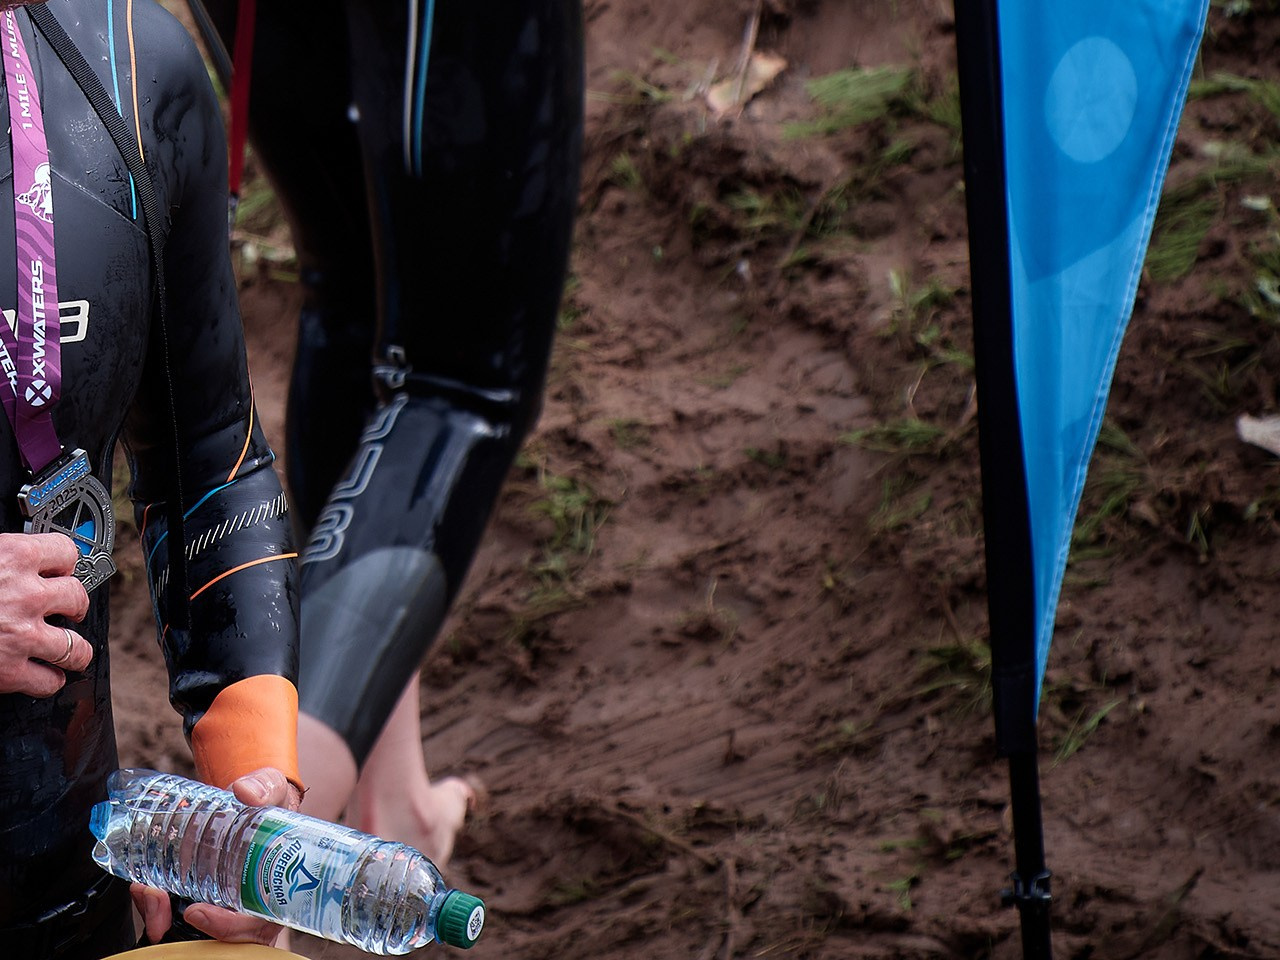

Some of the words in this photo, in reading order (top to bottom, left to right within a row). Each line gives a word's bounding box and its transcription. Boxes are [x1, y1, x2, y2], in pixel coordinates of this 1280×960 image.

[5, 10, 20, 58] MURO
[15, 73, 32, 118] MILE
[48, 485, 79, 513] 2025
[271, 839, 302, 906] ДИВЕЕВСКАЯ
